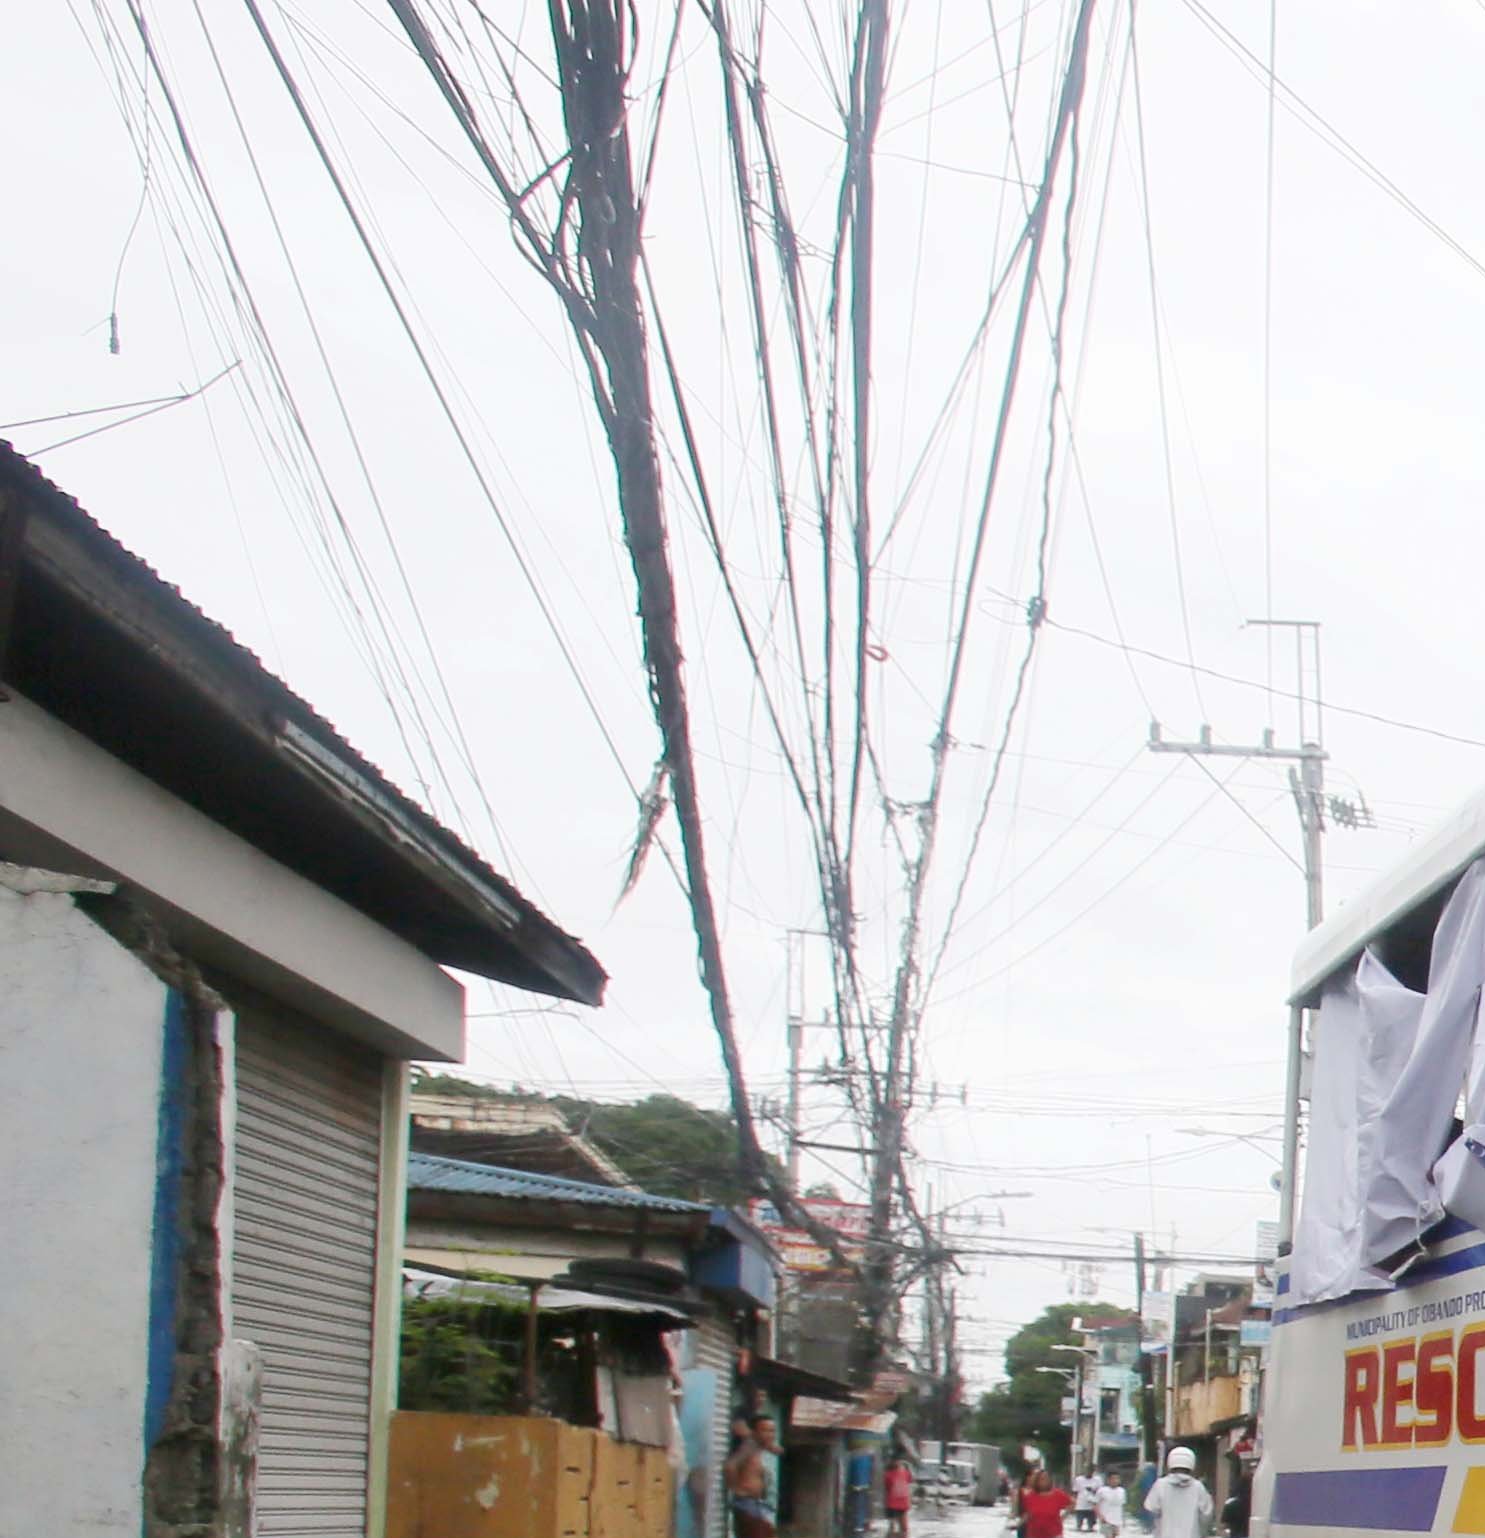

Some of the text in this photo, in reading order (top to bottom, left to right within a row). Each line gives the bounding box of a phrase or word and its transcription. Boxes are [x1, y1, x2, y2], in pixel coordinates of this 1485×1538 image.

[1346, 1311, 1407, 1340] MUNICIPALITY
[1408, 1307, 1420, 1327] OF
[1421, 1299, 1463, 1324] OBANDO
